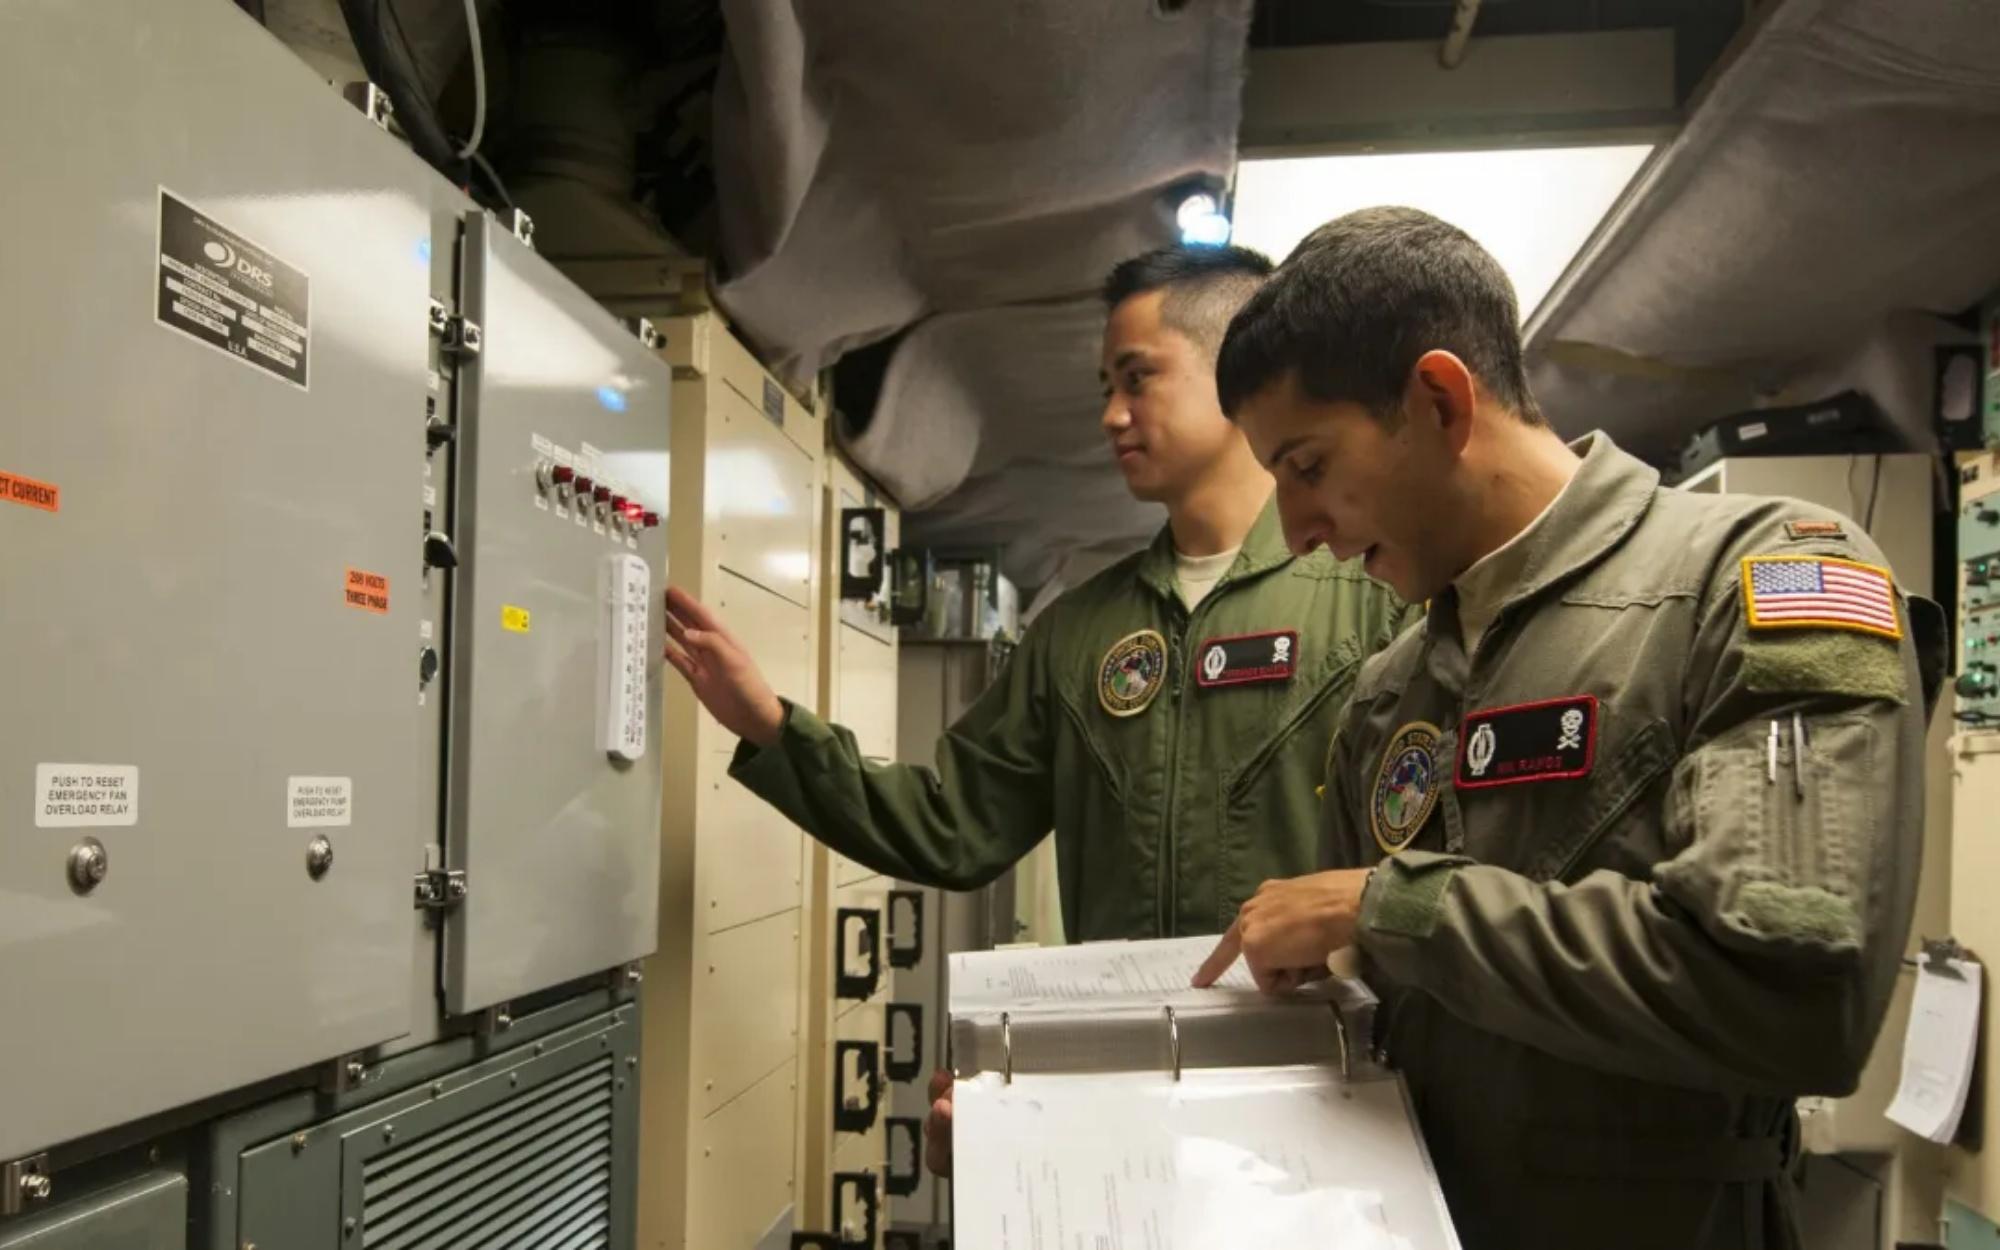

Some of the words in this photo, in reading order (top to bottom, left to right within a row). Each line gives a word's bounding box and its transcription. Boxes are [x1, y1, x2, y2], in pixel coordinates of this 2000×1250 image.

[237, 258, 273, 287] DRS
[12, 479, 57, 507] CURRENT
[346, 589, 367, 606] THREE
[367, 594, 388, 611] PHASE
[51, 776, 79, 788] PUSH
[80, 776, 94, 788] TO
[96, 776, 126, 788] RESET
[48, 789, 107, 801] EMERGENCY
[109, 789, 128, 801] FAN
[45, 804, 97, 816] OVERLOAD
[99, 804, 129, 816] RELAY
